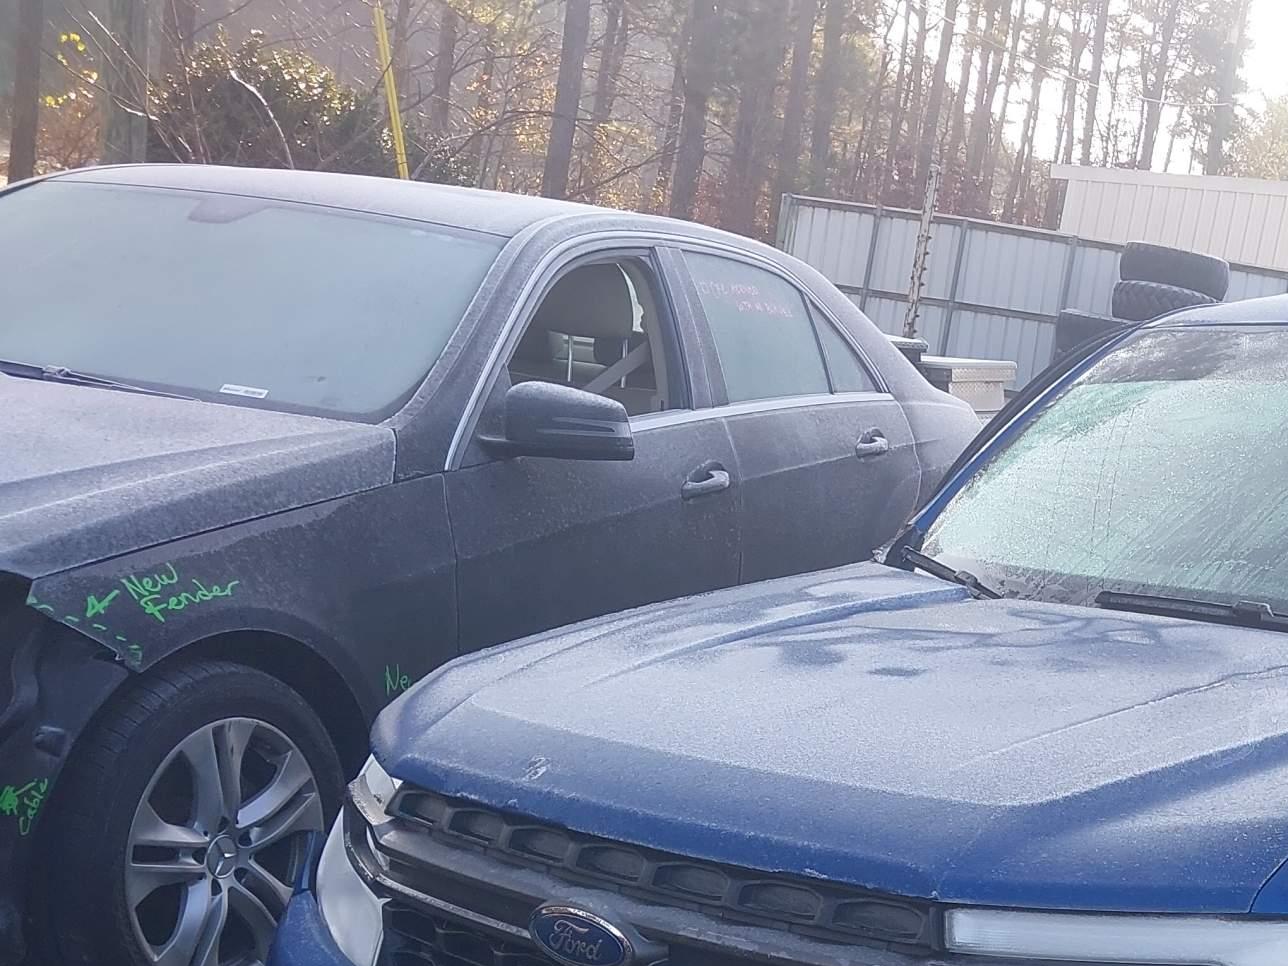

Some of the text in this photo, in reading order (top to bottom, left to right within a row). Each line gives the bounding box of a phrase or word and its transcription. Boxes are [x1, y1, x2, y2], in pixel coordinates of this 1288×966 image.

[120, 562, 178, 600] New
[140, 578, 240, 622] Fender
[385, 663, 411, 697] Ne
[548, 918, 604, 960] Ford
